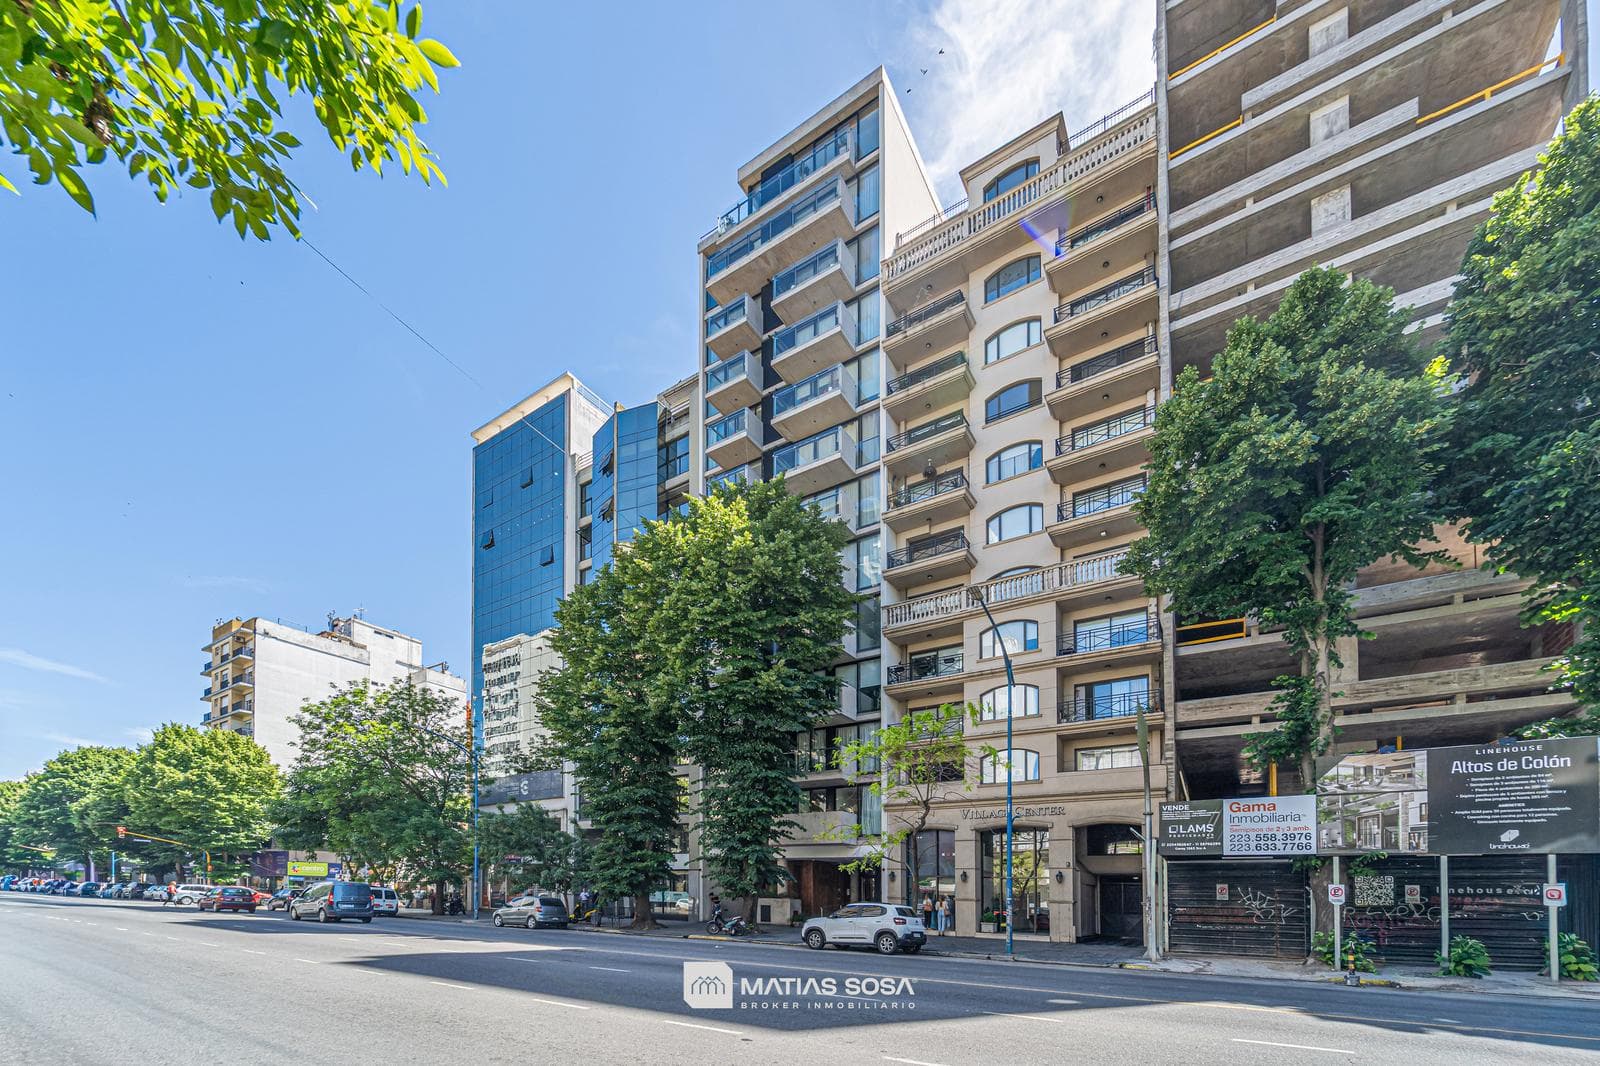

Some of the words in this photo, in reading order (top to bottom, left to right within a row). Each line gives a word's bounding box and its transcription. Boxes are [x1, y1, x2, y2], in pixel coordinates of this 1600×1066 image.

[1475, 744, 1544, 755] LINEHOUSE
[1451, 759, 1493, 774] Altos
[1497, 758, 1518, 772] de
[1521, 754, 1572, 770] Colón
[962, 808, 1008, 819] VILLAG
[1015, 806, 1066, 817] CENTER
[1229, 802, 1276, 813] Gama
[1229, 812, 1302, 823] Inmobiliaria
[1229, 832, 1312, 843] 223.558.3976
[1229, 842, 1312, 852] 223.633.7766
